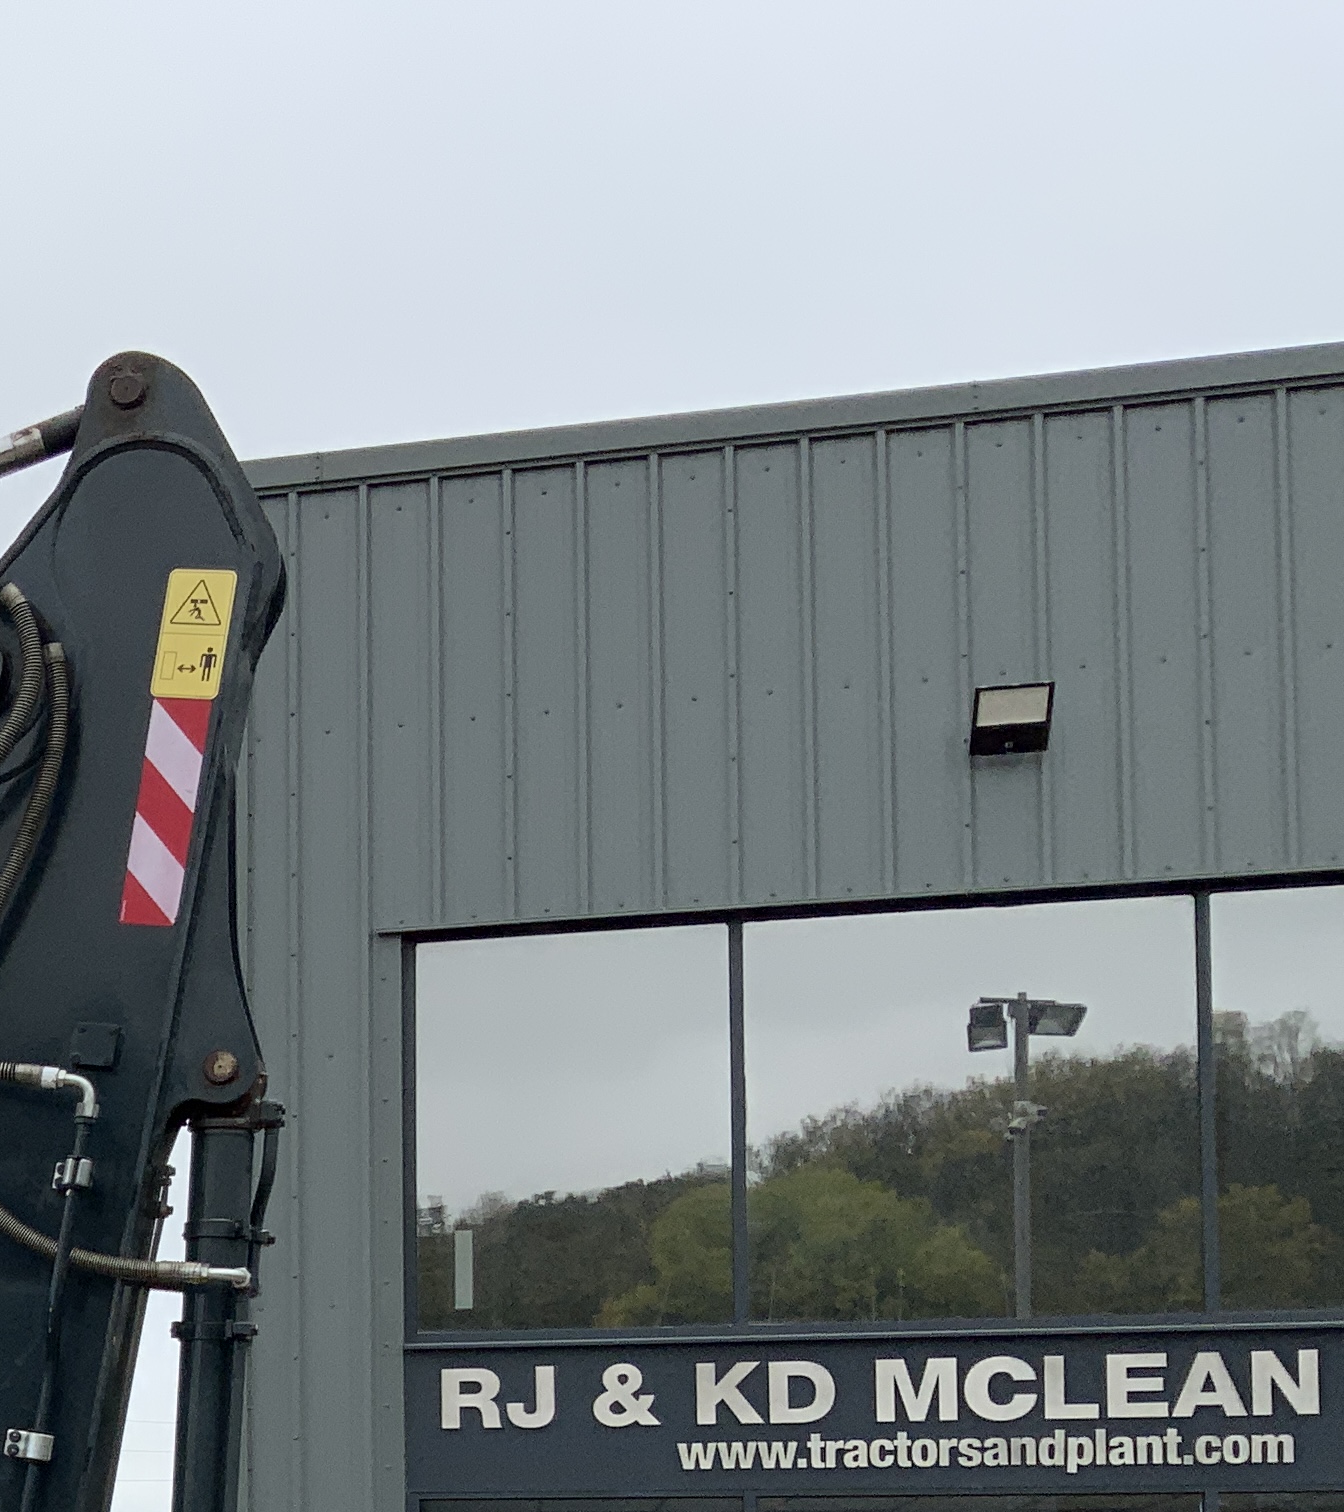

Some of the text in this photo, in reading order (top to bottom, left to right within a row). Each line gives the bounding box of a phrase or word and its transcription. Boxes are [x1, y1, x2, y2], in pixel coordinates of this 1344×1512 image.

[440, 1348, 1321, 1430] RJ & KD MCLEAN
[676, 1427, 1296, 1474] www.tractorsandplant.com
